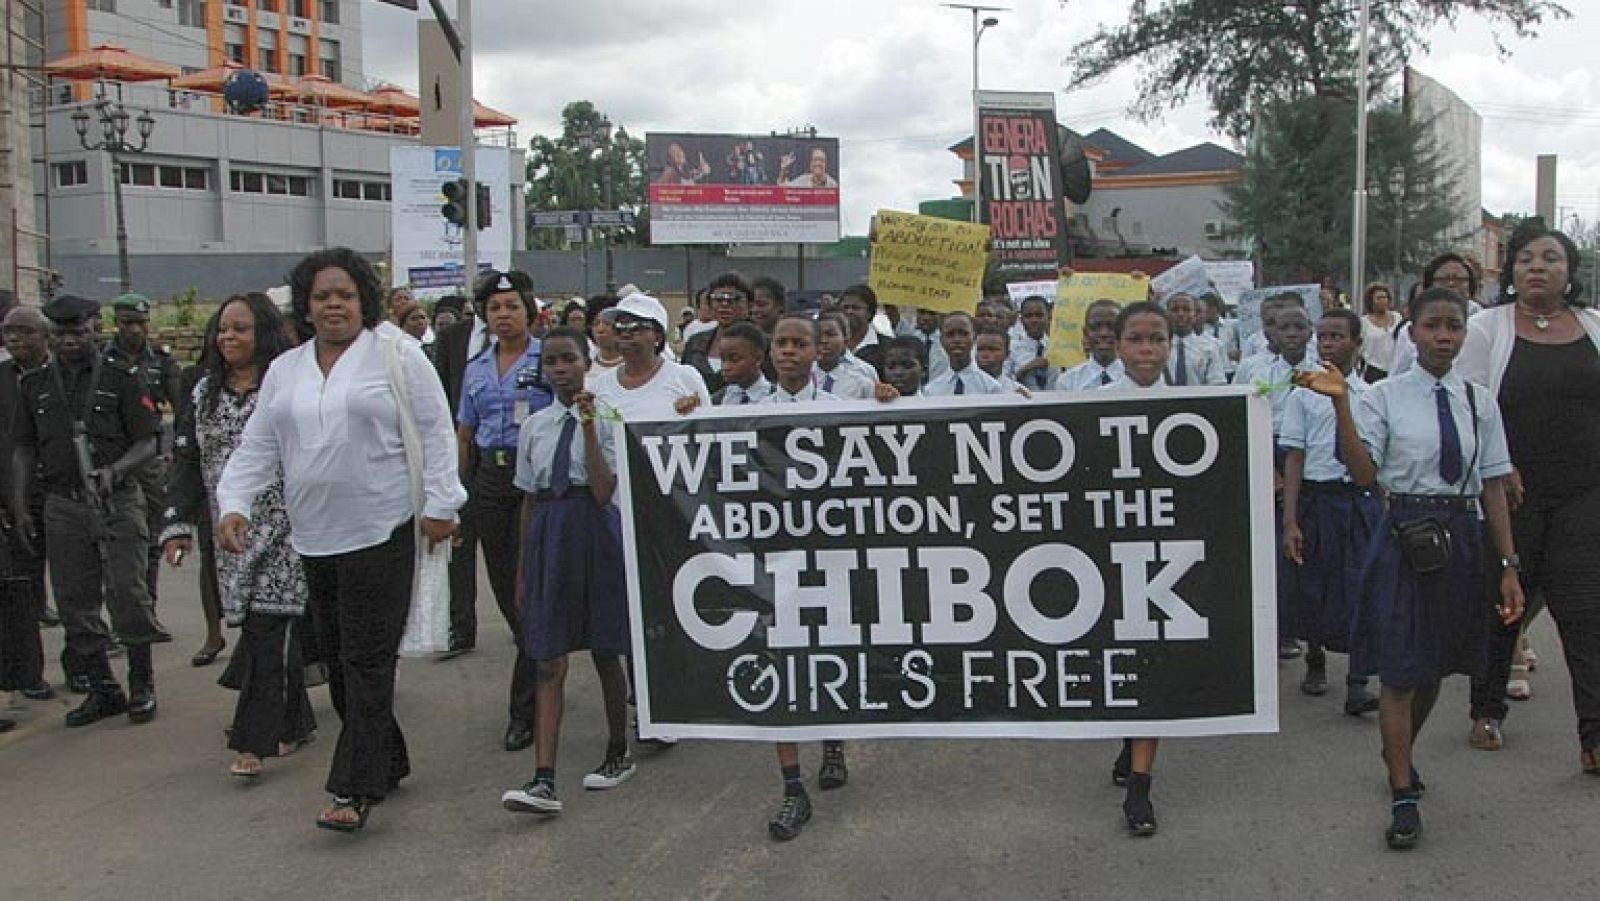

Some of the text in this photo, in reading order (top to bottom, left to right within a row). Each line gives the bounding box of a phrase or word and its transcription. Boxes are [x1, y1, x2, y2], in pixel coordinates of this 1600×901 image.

[982, 116, 1049, 154] GENERA
[989, 201, 1057, 238] ROCHAS
[642, 412, 1220, 495] WE SAY NO TO
[689, 487, 1176, 541] ABDUCTION, SET THE
[672, 540, 1209, 650] CHIBOK
[726, 648, 1140, 713] GIRLS FREE
